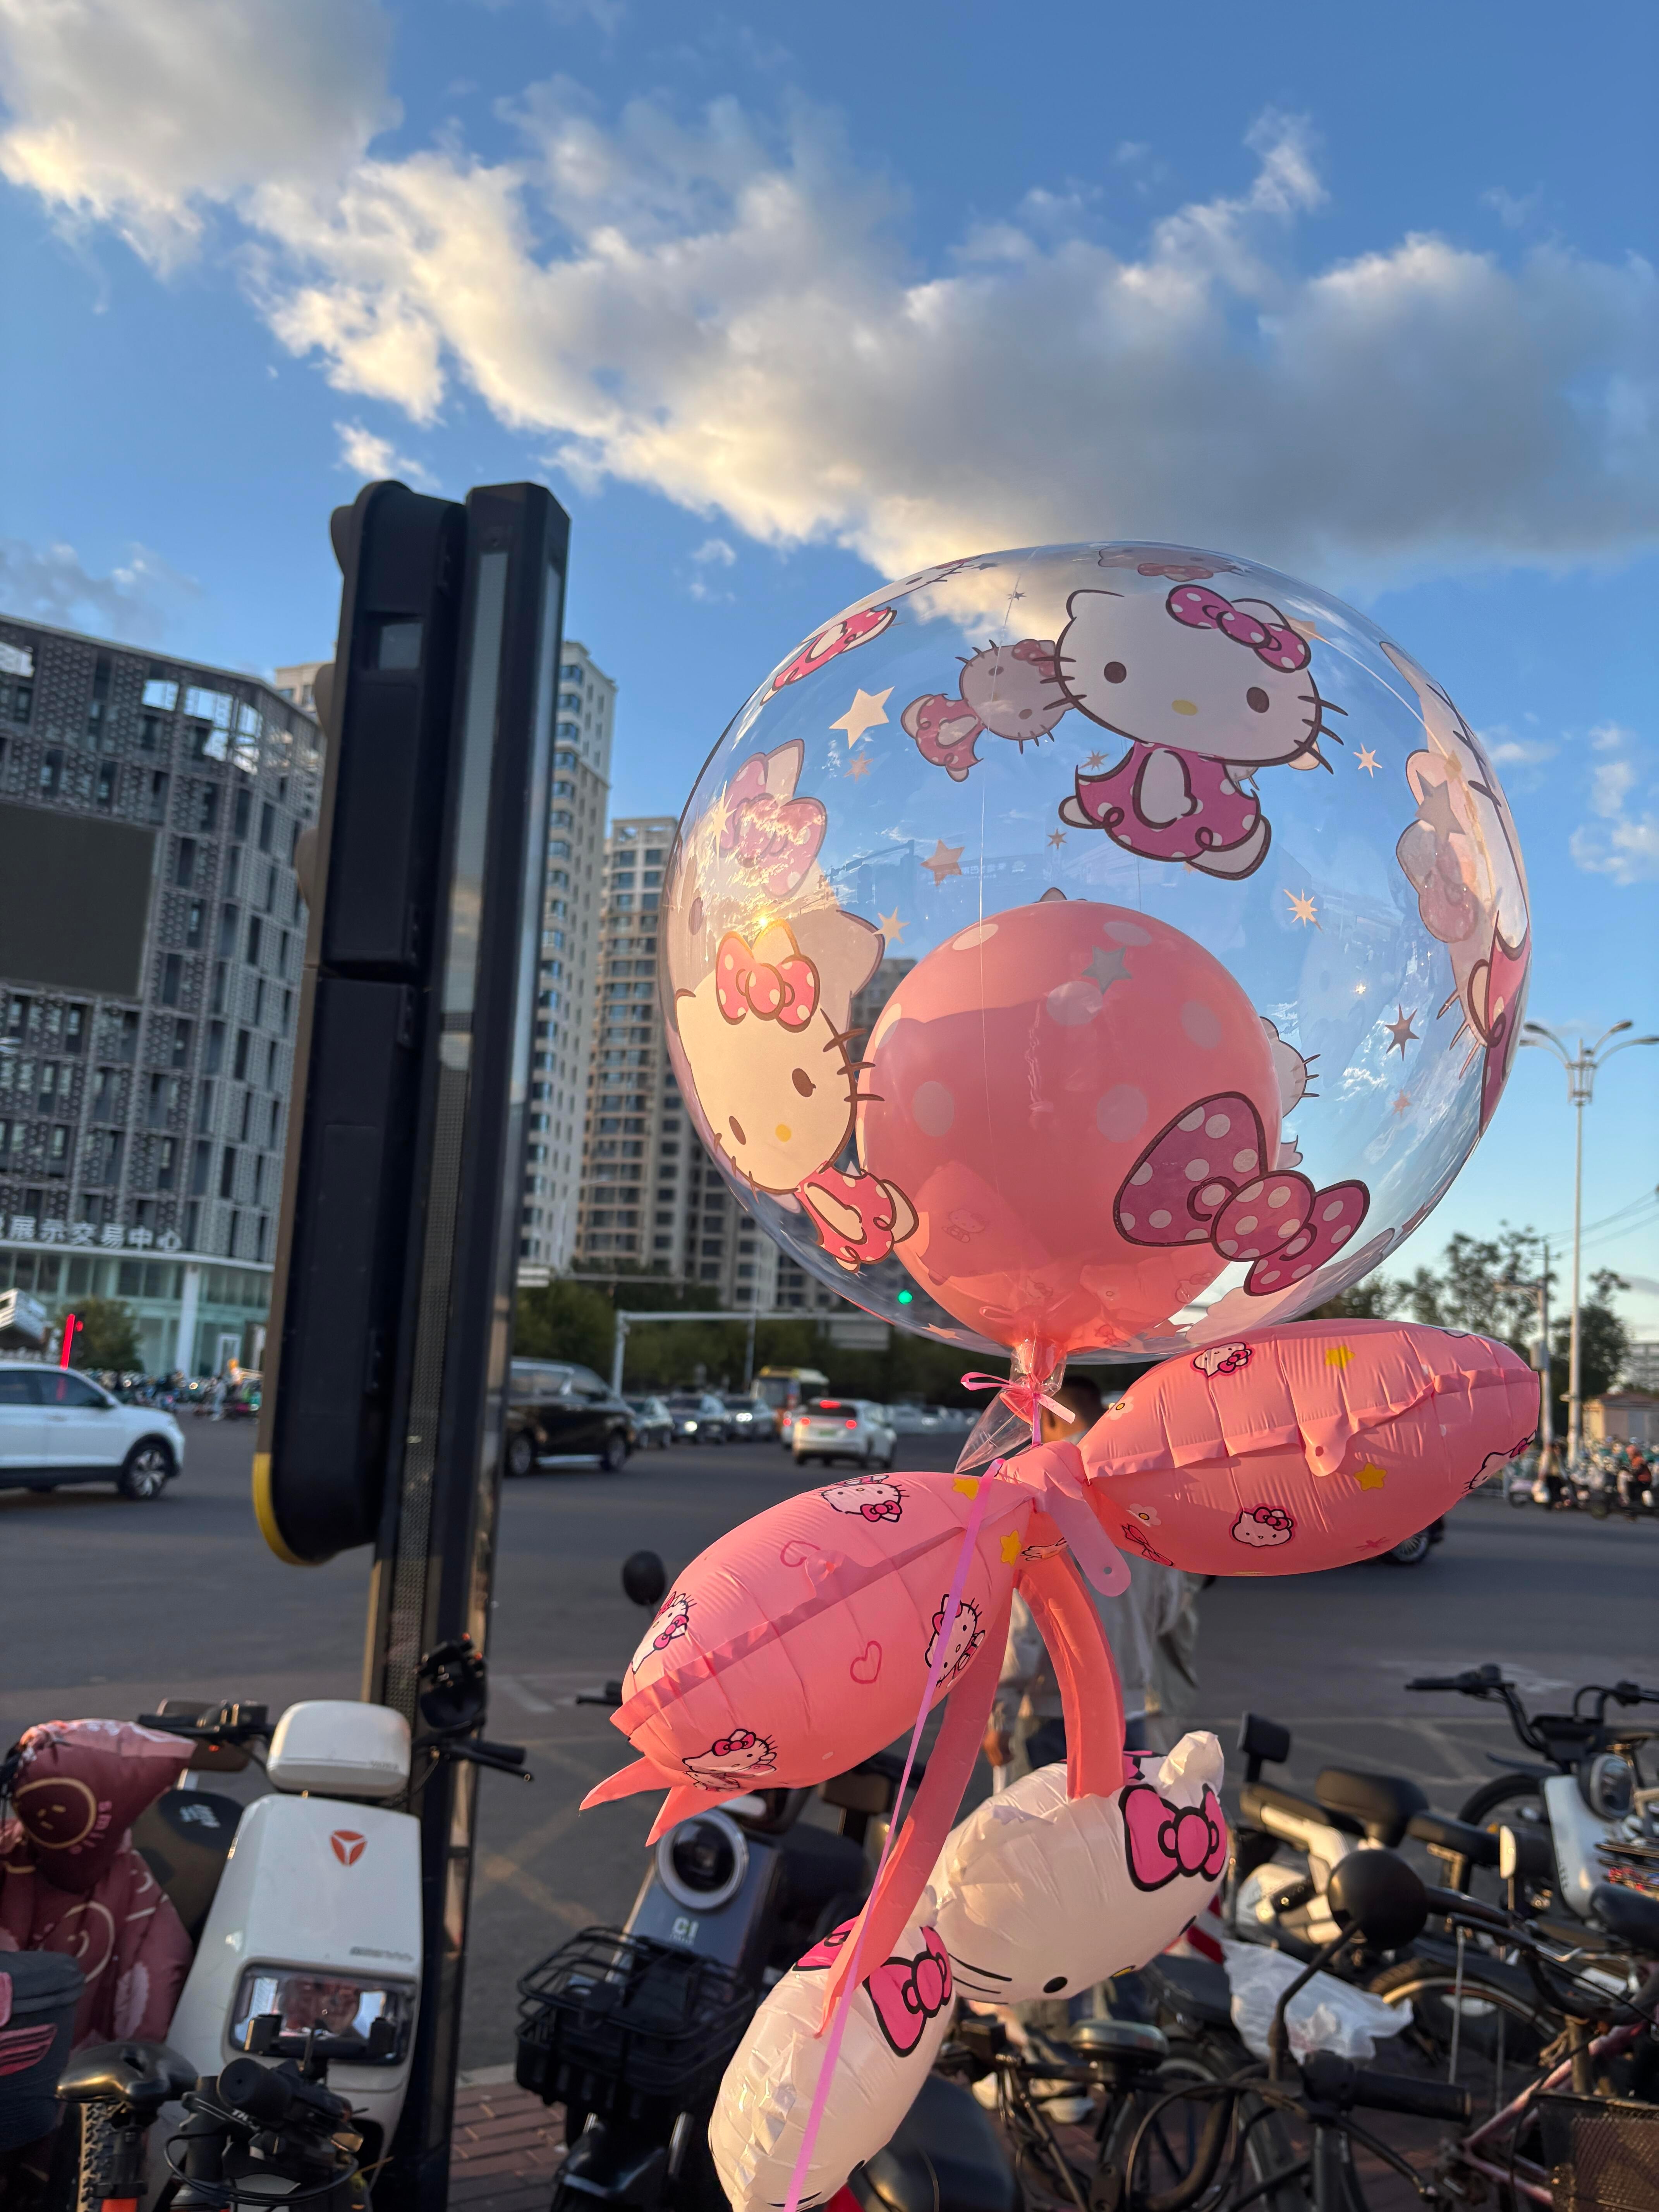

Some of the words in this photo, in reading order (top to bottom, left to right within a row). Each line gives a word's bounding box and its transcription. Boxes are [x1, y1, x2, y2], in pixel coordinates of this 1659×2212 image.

[0, 1214, 182, 1252] 展示交易中心
